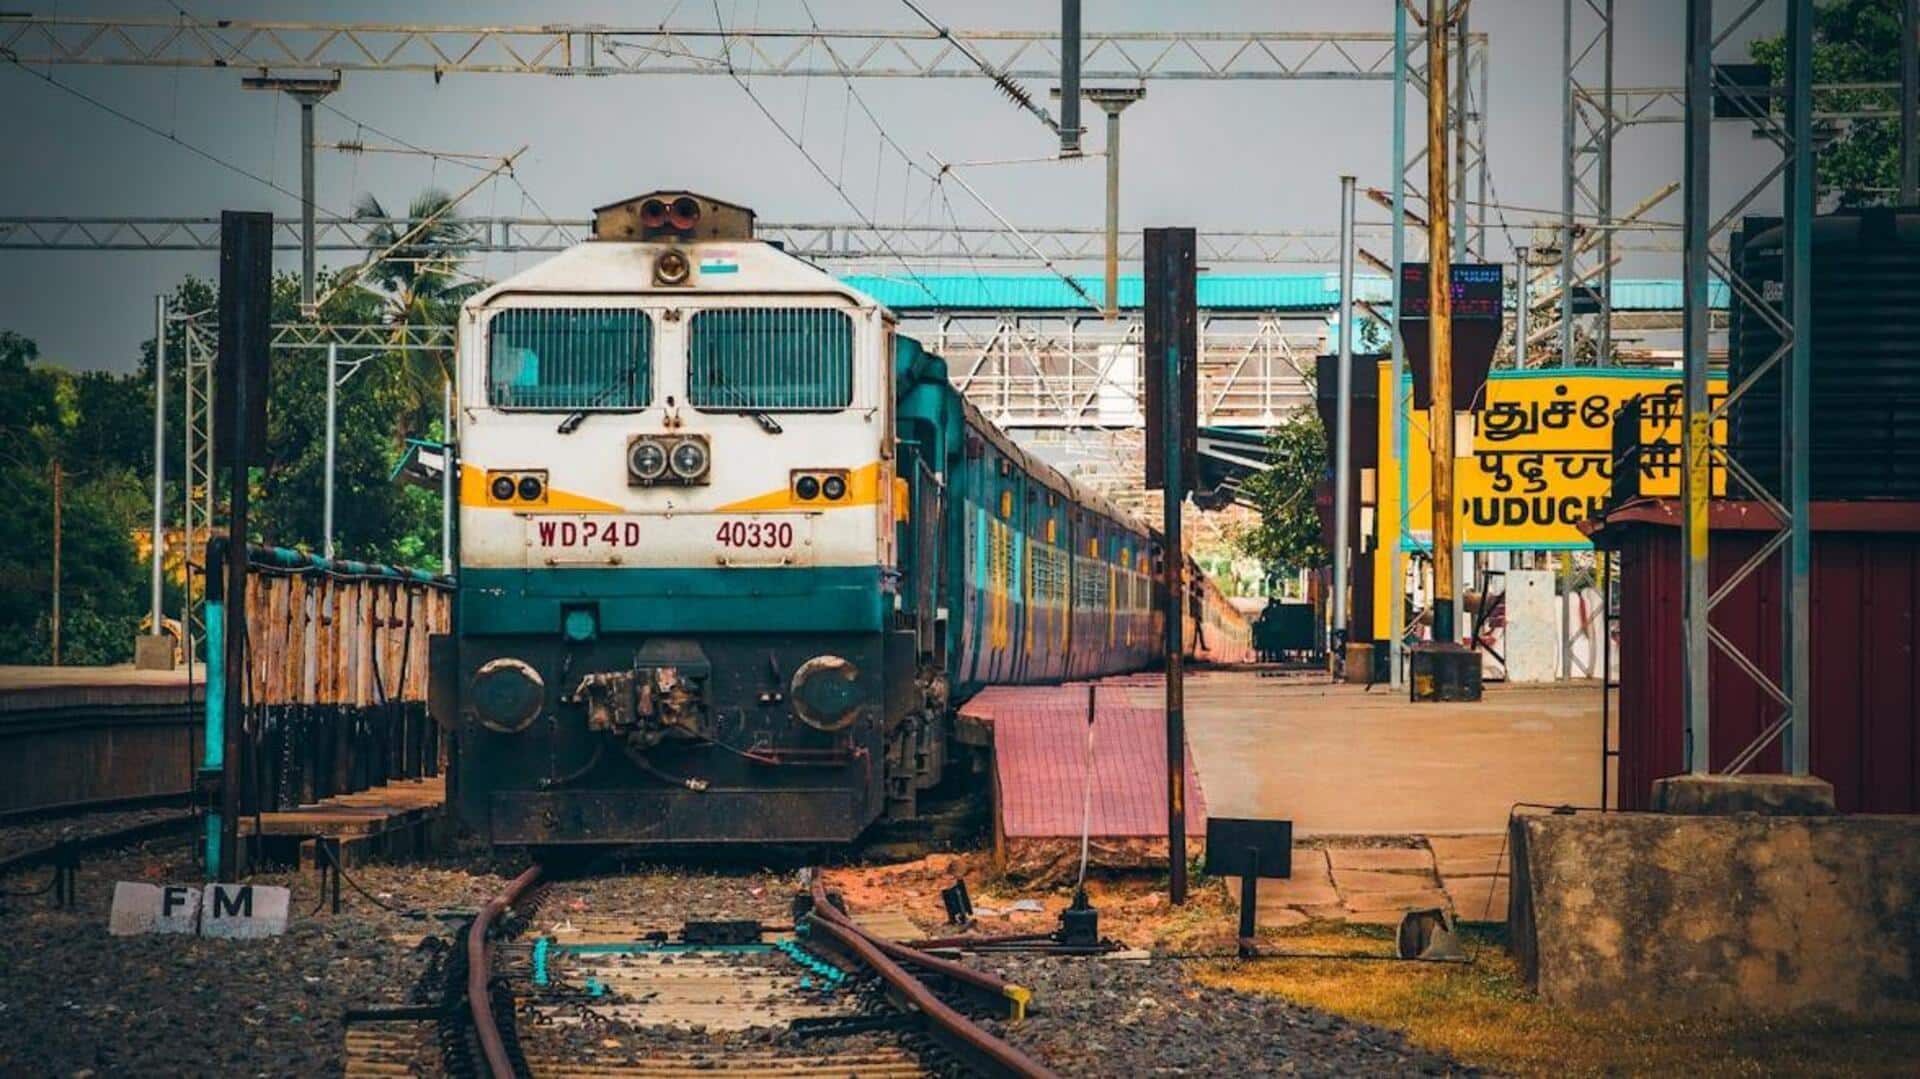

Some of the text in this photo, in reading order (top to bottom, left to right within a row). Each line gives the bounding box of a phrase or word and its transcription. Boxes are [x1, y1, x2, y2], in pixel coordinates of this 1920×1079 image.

[1463, 496, 1609, 526] UDUCH
[539, 521, 793, 548] WDP4D 40330
